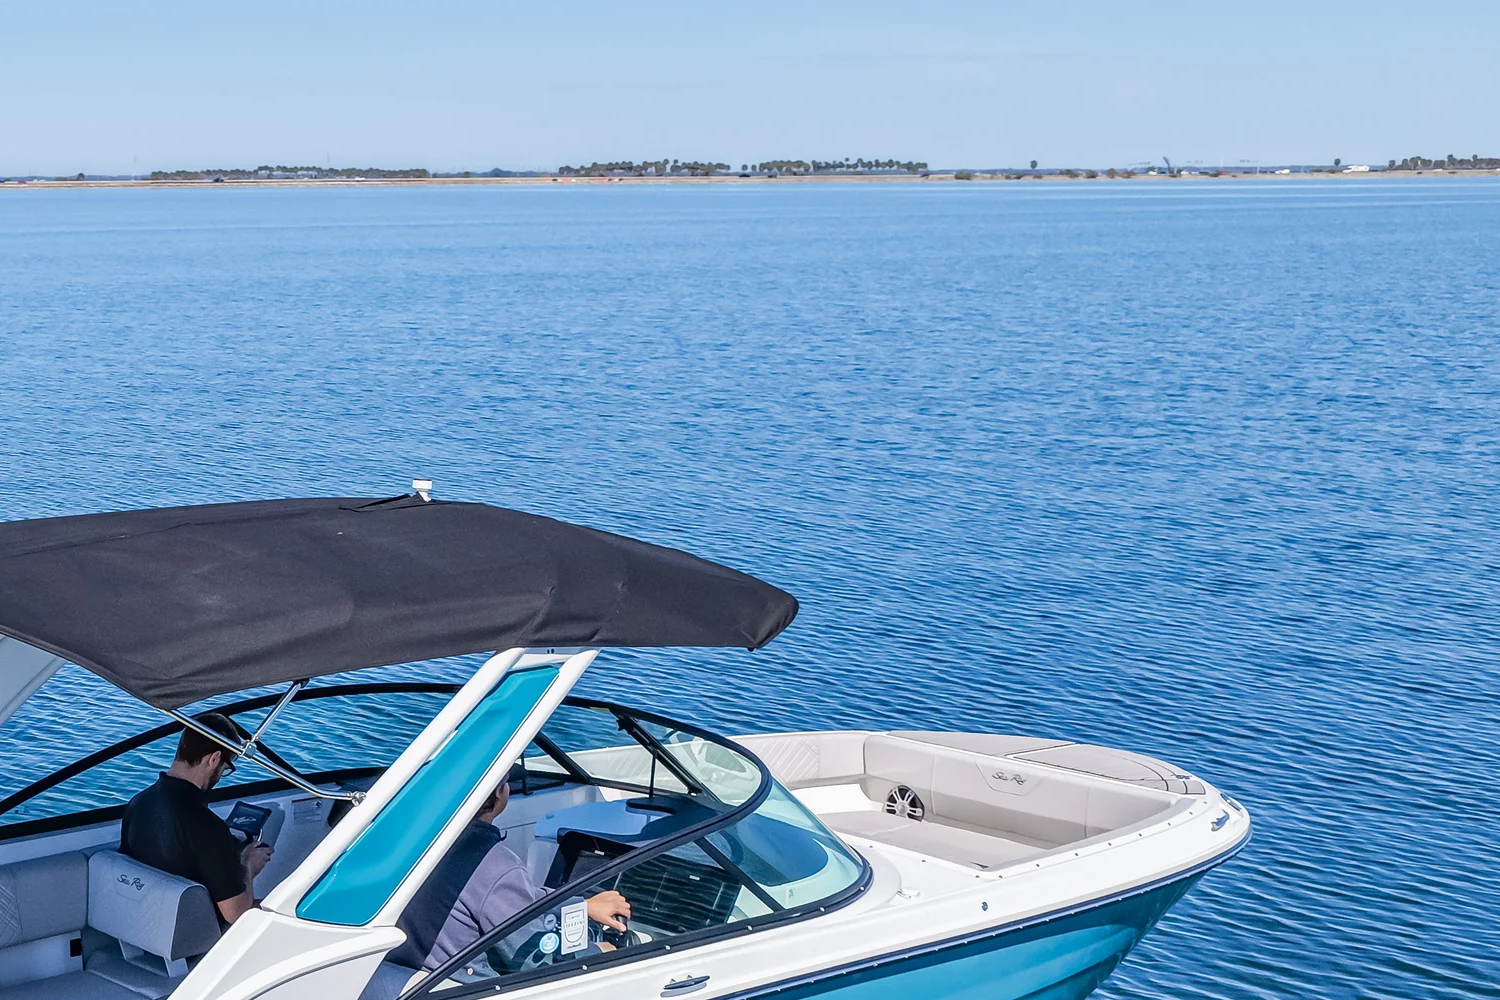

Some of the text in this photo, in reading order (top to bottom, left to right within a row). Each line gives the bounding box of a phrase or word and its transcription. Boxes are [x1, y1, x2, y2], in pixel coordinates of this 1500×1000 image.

[992, 771, 1009, 781] Sea
[116, 874, 145, 891] Sea Ray
